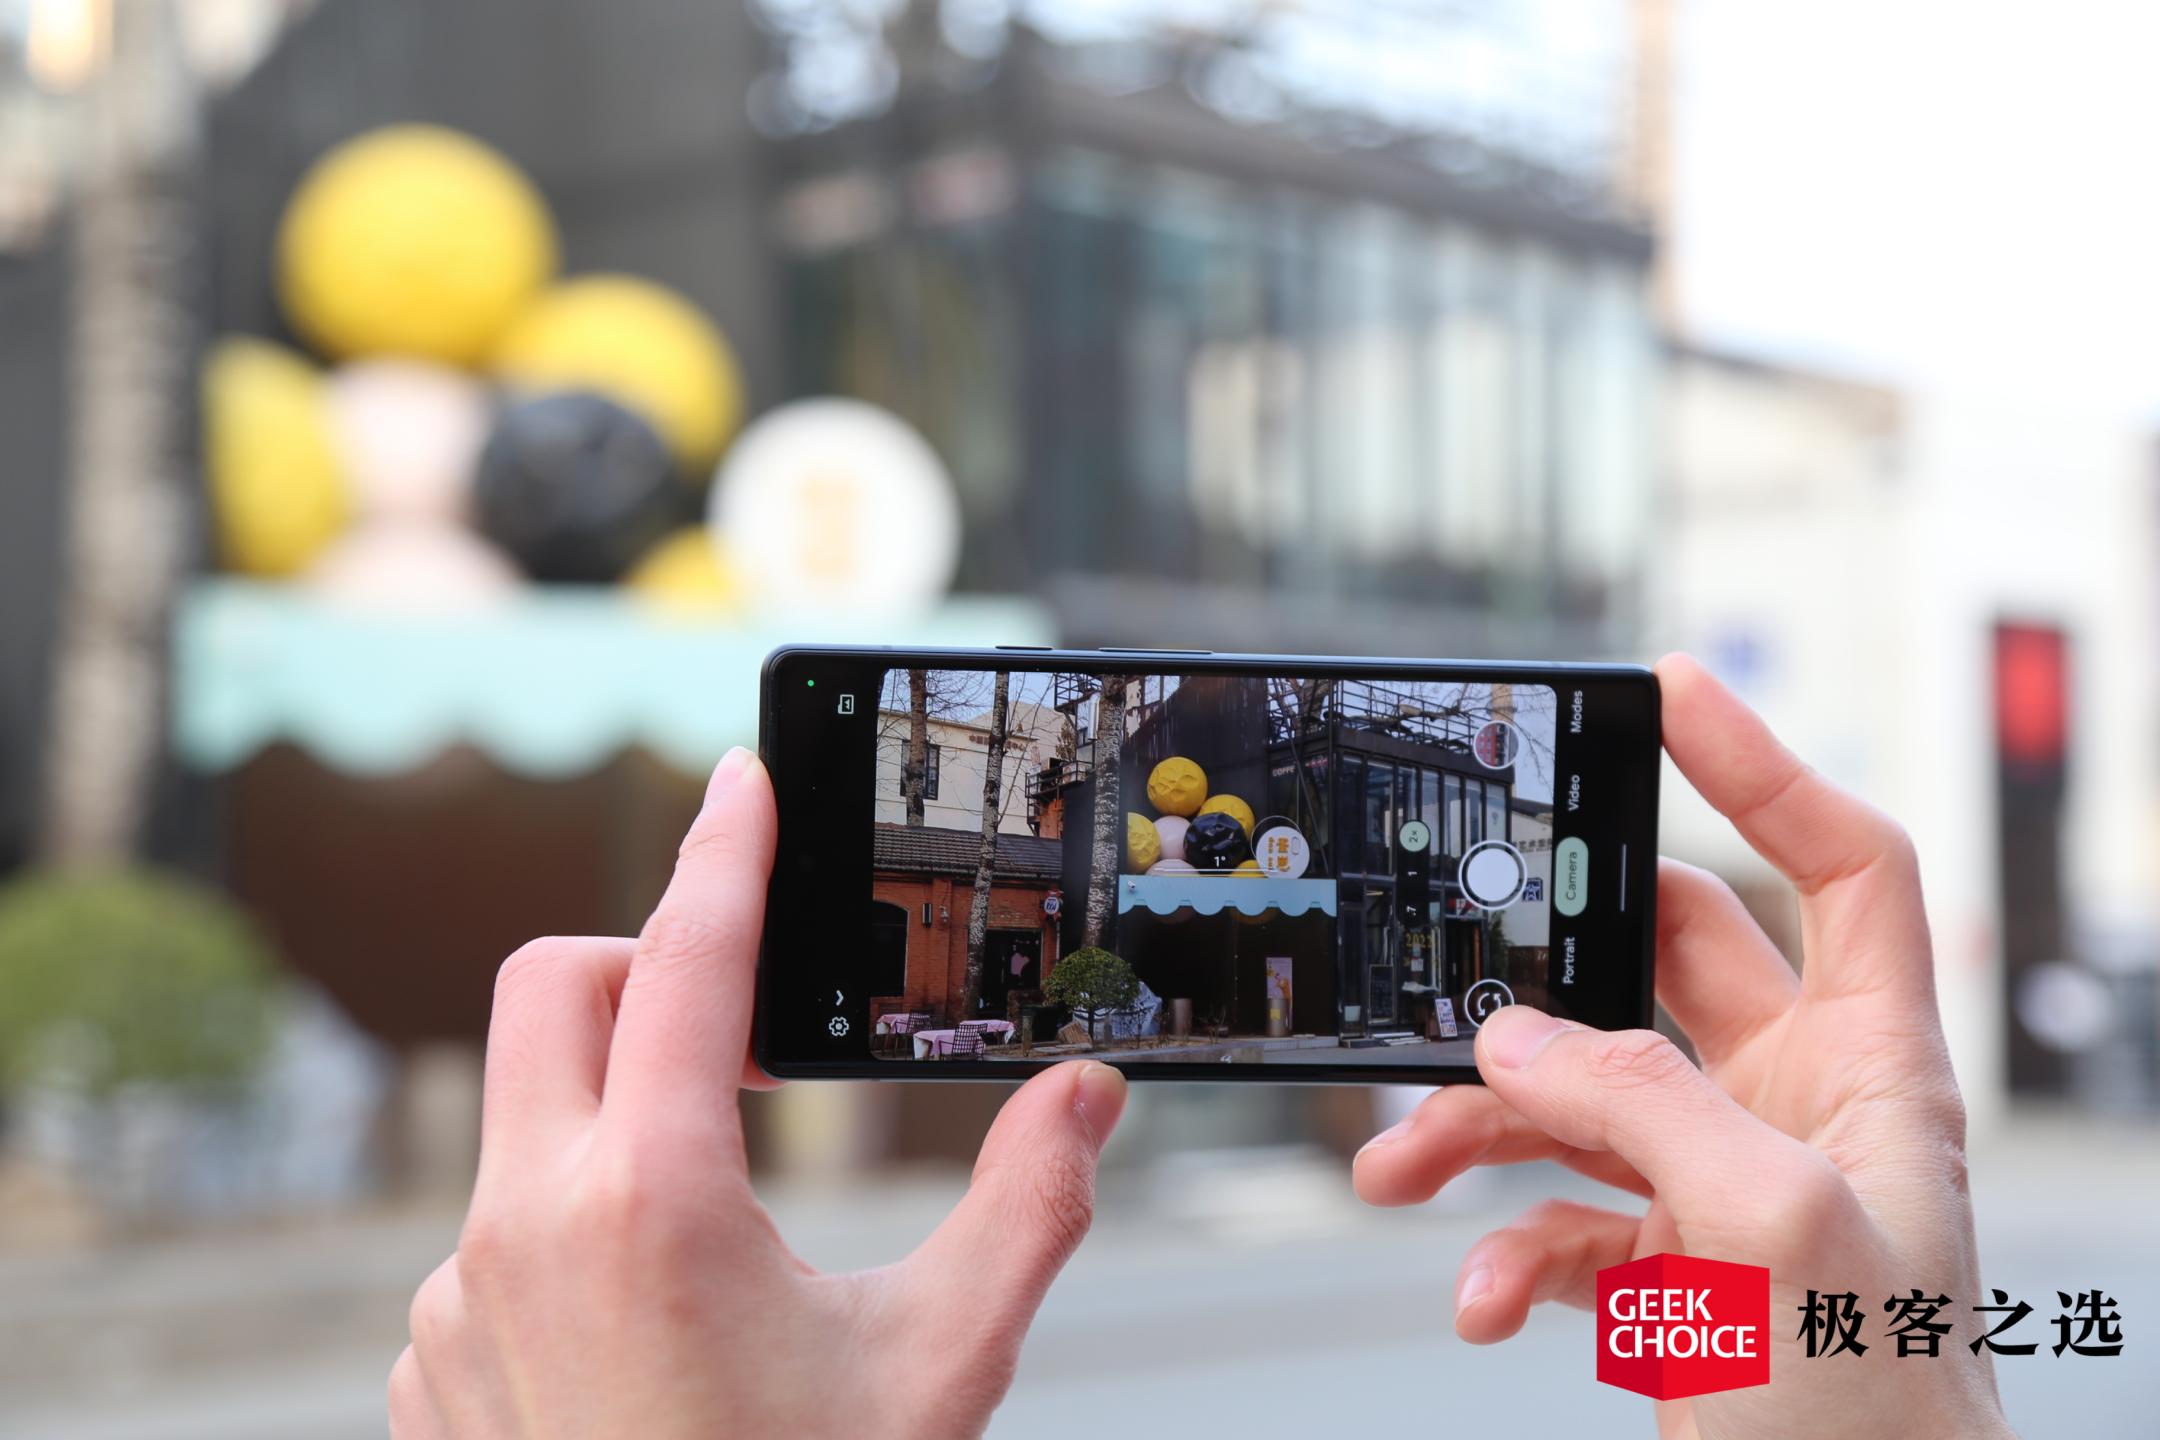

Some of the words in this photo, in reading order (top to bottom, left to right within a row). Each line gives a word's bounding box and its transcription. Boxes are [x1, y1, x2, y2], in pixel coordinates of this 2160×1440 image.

[1571, 690, 1583, 733] Modes
[1568, 774, 1580, 811] Video
[1566, 851, 1578, 901] Camera
[1562, 936, 1575, 985] Portrait
